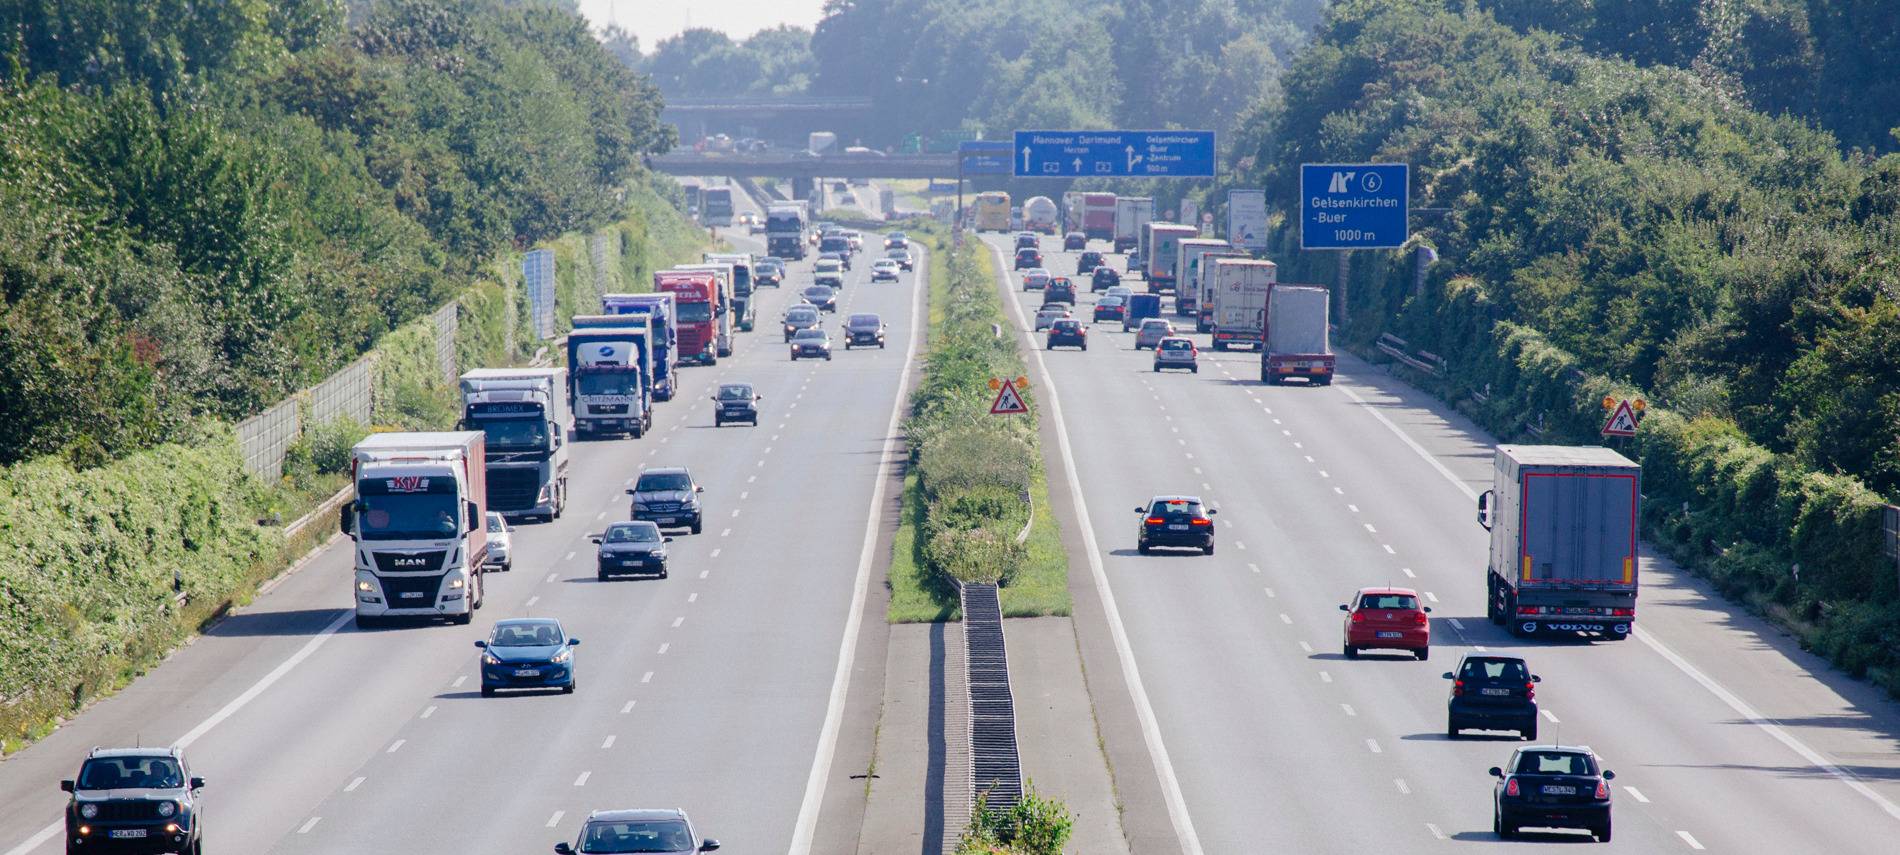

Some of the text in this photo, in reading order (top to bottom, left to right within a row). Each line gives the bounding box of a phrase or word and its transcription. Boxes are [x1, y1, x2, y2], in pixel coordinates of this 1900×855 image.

[1079, 136, 1121, 144] Dortmund
[1146, 136, 1199, 144] Gelsenkirchen
[1368, 176, 1376, 188] 6
[1312, 197, 1398, 208] Gelsenkirchen
[1312, 212, 1347, 223] -Buer
[1335, 229, 1376, 241] 1000 m
[1547, 623, 1604, 631] VOLVO
